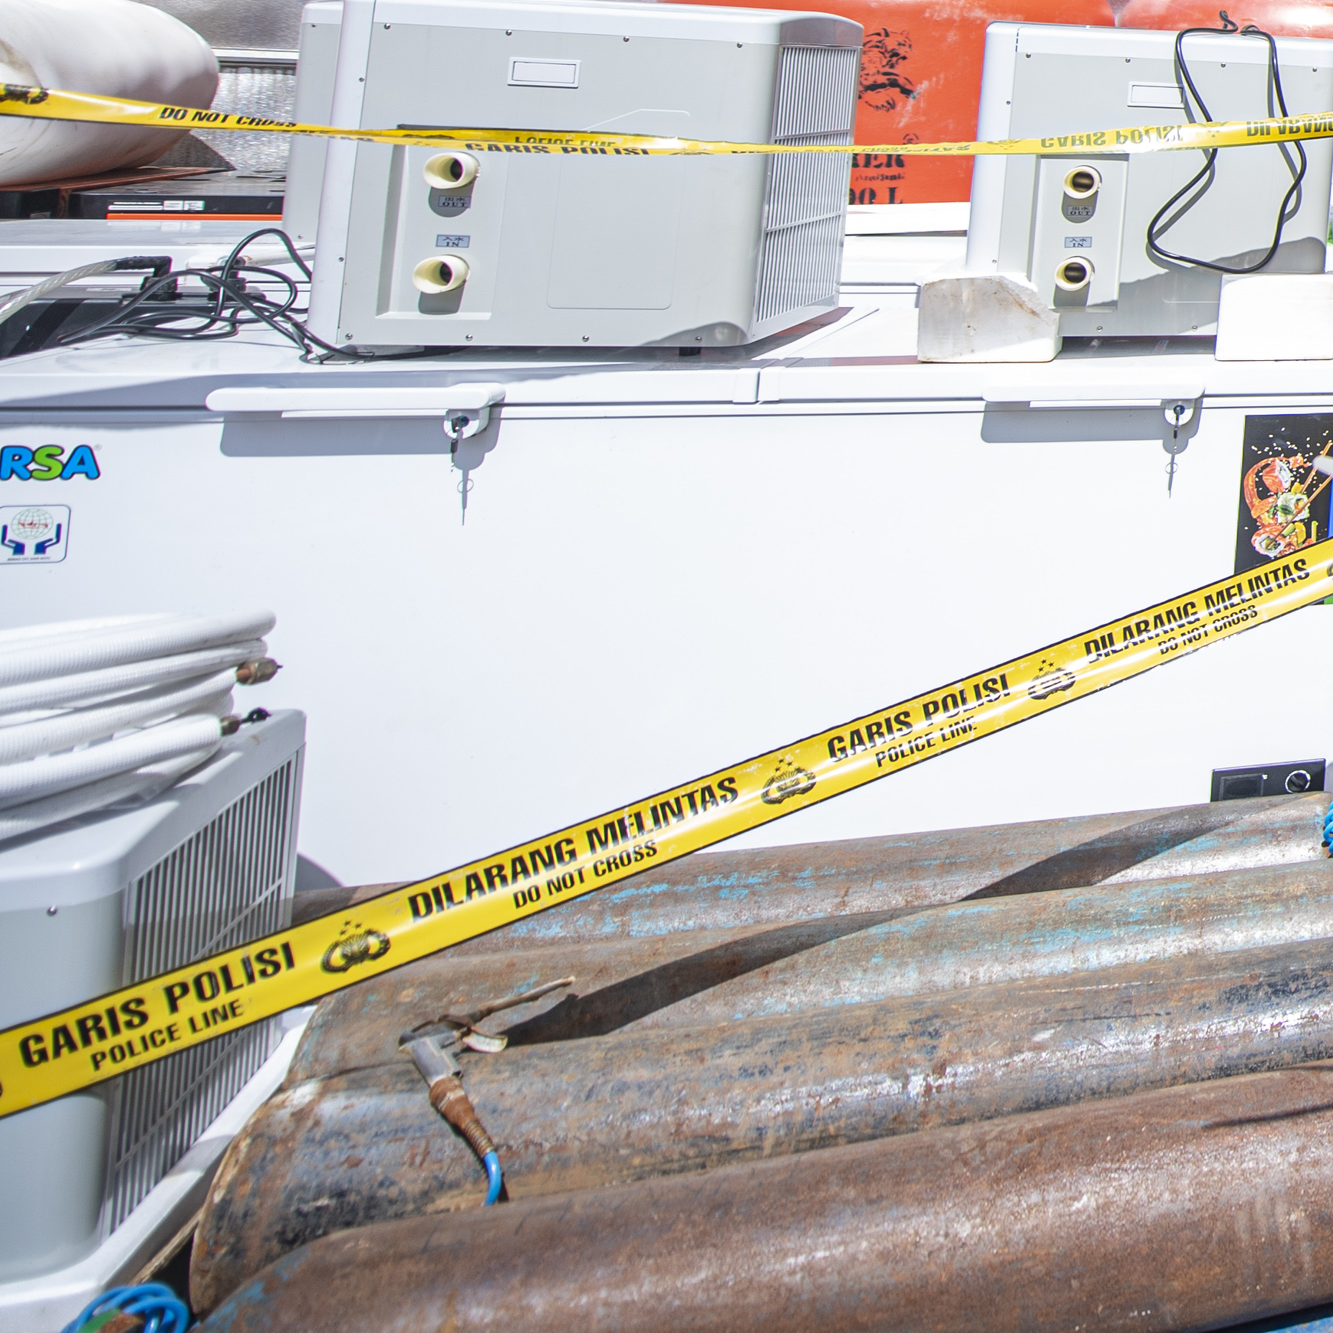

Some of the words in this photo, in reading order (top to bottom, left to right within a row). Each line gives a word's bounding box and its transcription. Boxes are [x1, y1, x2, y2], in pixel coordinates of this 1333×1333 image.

[160, 107, 187, 120] DO
[191, 111, 233, 123] NOT
[0, 445, 101, 481] RSA
[1083, 602, 1203, 666] DILARANG
[1205, 557, 1312, 622] MELINTAS
[1157, 634, 1177, 657] DO
[1213, 605, 1259, 640] CROSS
[828, 711, 915, 766] GARIS
[923, 674, 1011, 734] POLISI
[875, 733, 936, 771] POLICE
[938, 716, 978, 748] LINE
[406, 838, 578, 924] DILARANG
[585, 776, 741, 853] MELINTAS
[512, 883, 545, 910] DO
[546, 869, 586, 899] NOT
[592, 839, 659, 879] CROSS
[18, 986, 149, 1071] GARIS
[165, 940, 296, 1017] POLISI
[90, 1022, 184, 1072] POLICE
[190, 998, 244, 1045] LINE
